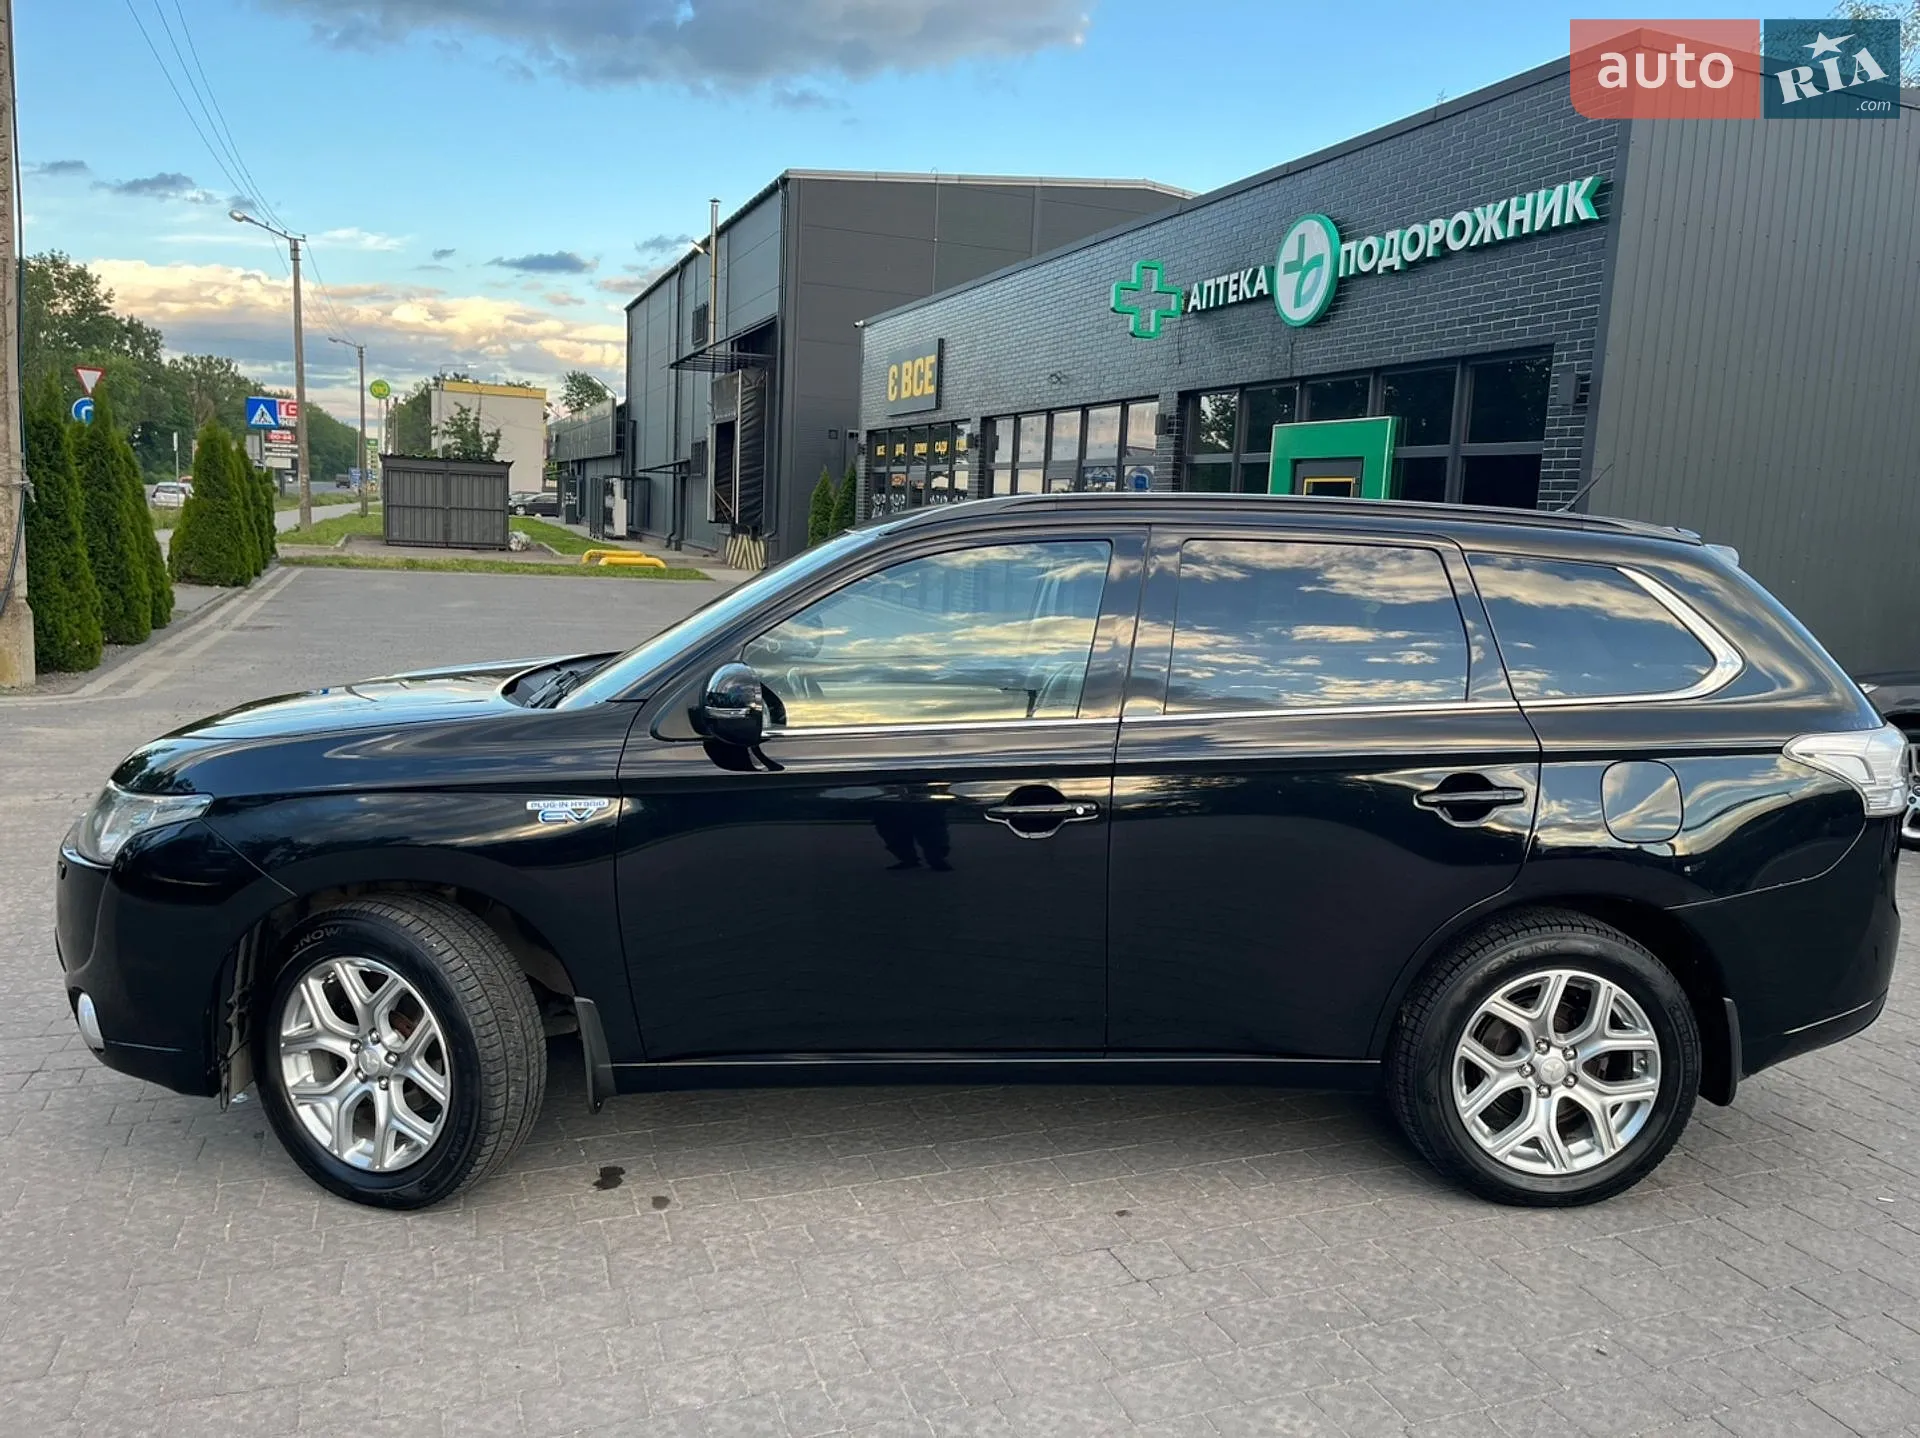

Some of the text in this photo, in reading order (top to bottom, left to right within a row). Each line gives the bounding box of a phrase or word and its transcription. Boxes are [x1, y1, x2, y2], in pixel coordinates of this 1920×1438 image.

[1187, 176, 1601, 313] АПТЕКА ПОДОРОЖНИК
[901, 354, 936, 400] ВСЕ
